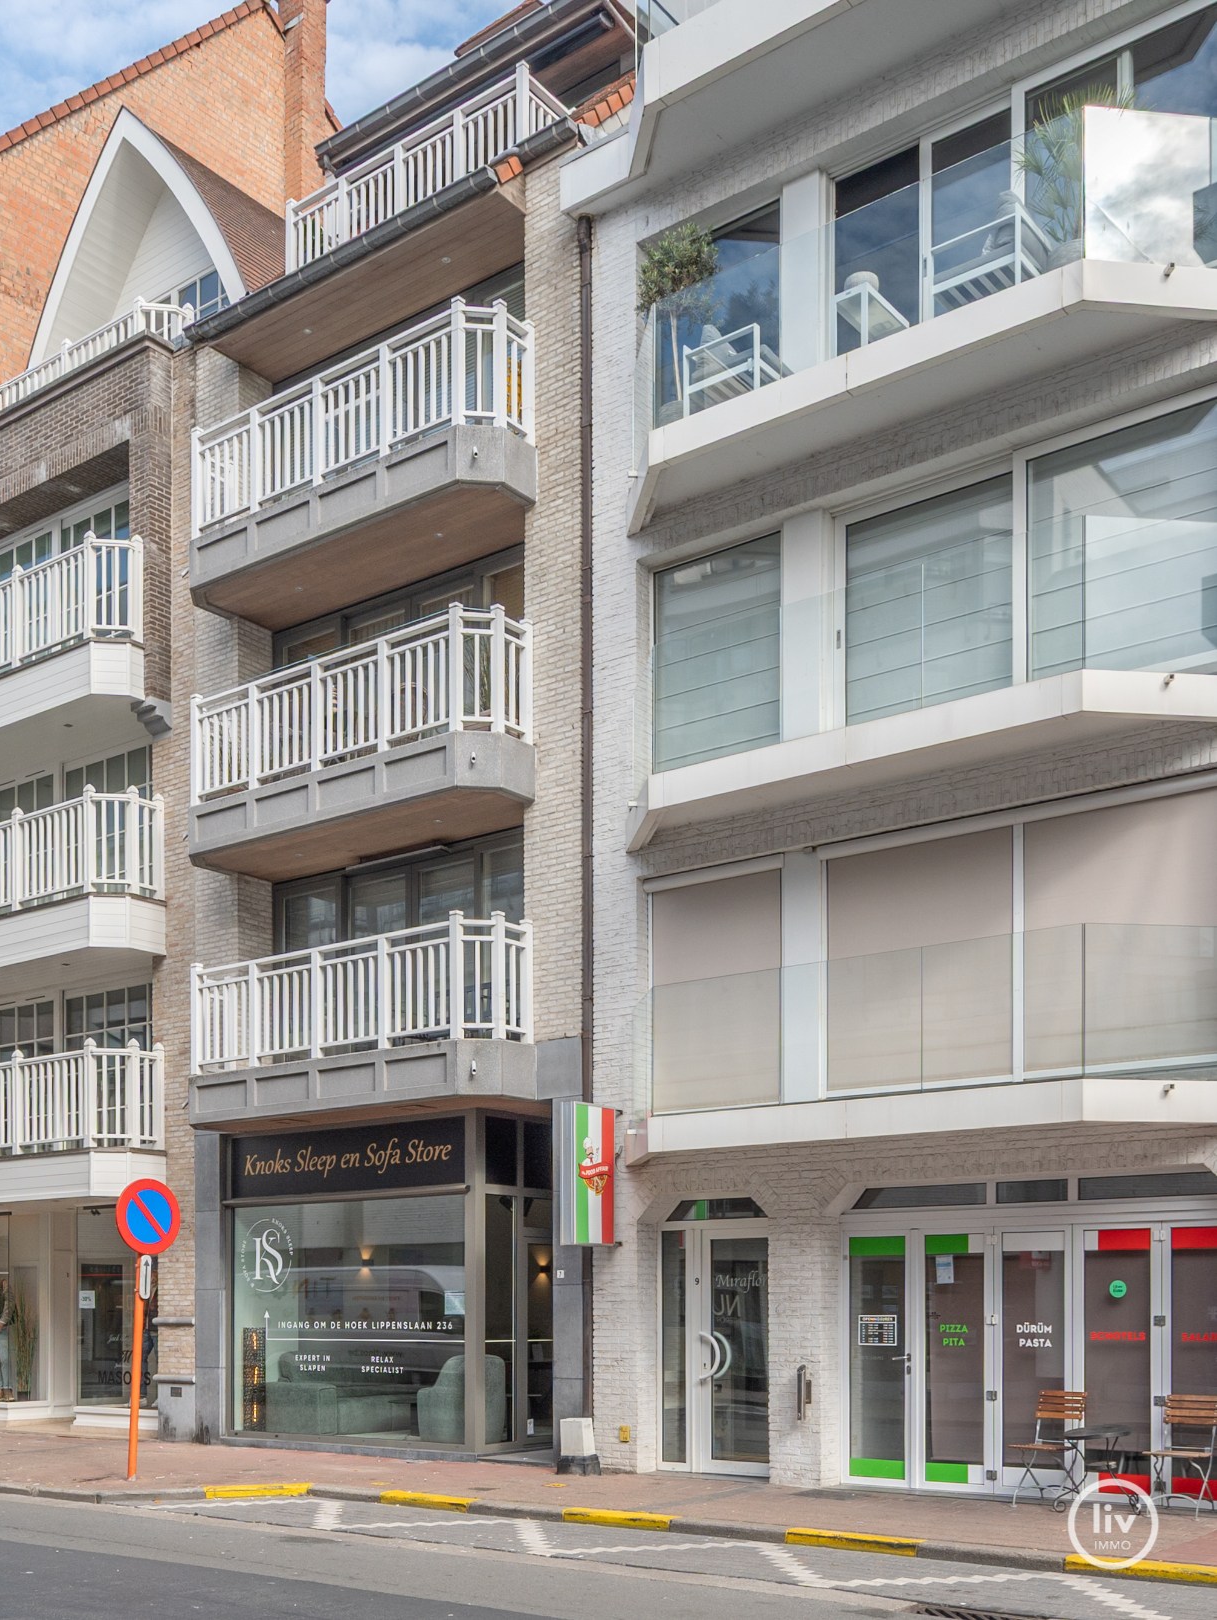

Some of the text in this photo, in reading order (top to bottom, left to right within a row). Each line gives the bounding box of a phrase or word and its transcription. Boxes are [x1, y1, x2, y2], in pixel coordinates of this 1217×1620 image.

[244, 1137, 452, 1178] Knoks Sleep en Sofa Store
[694, 1277, 700, 1286] 9
[277, 1321, 453, 1330] INGANG OM DE HOEK LIPPENSLAAN 236
[939, 1324, 968, 1333] PIZZA
[1016, 1322, 1052, 1333] DÜRÜM
[942, 1338, 965, 1346] PITA
[1019, 1339, 1052, 1348] PASTA
[299, 1364, 326, 1372] SLAPEN
[361, 1365, 404, 1374] SPECIALIST
